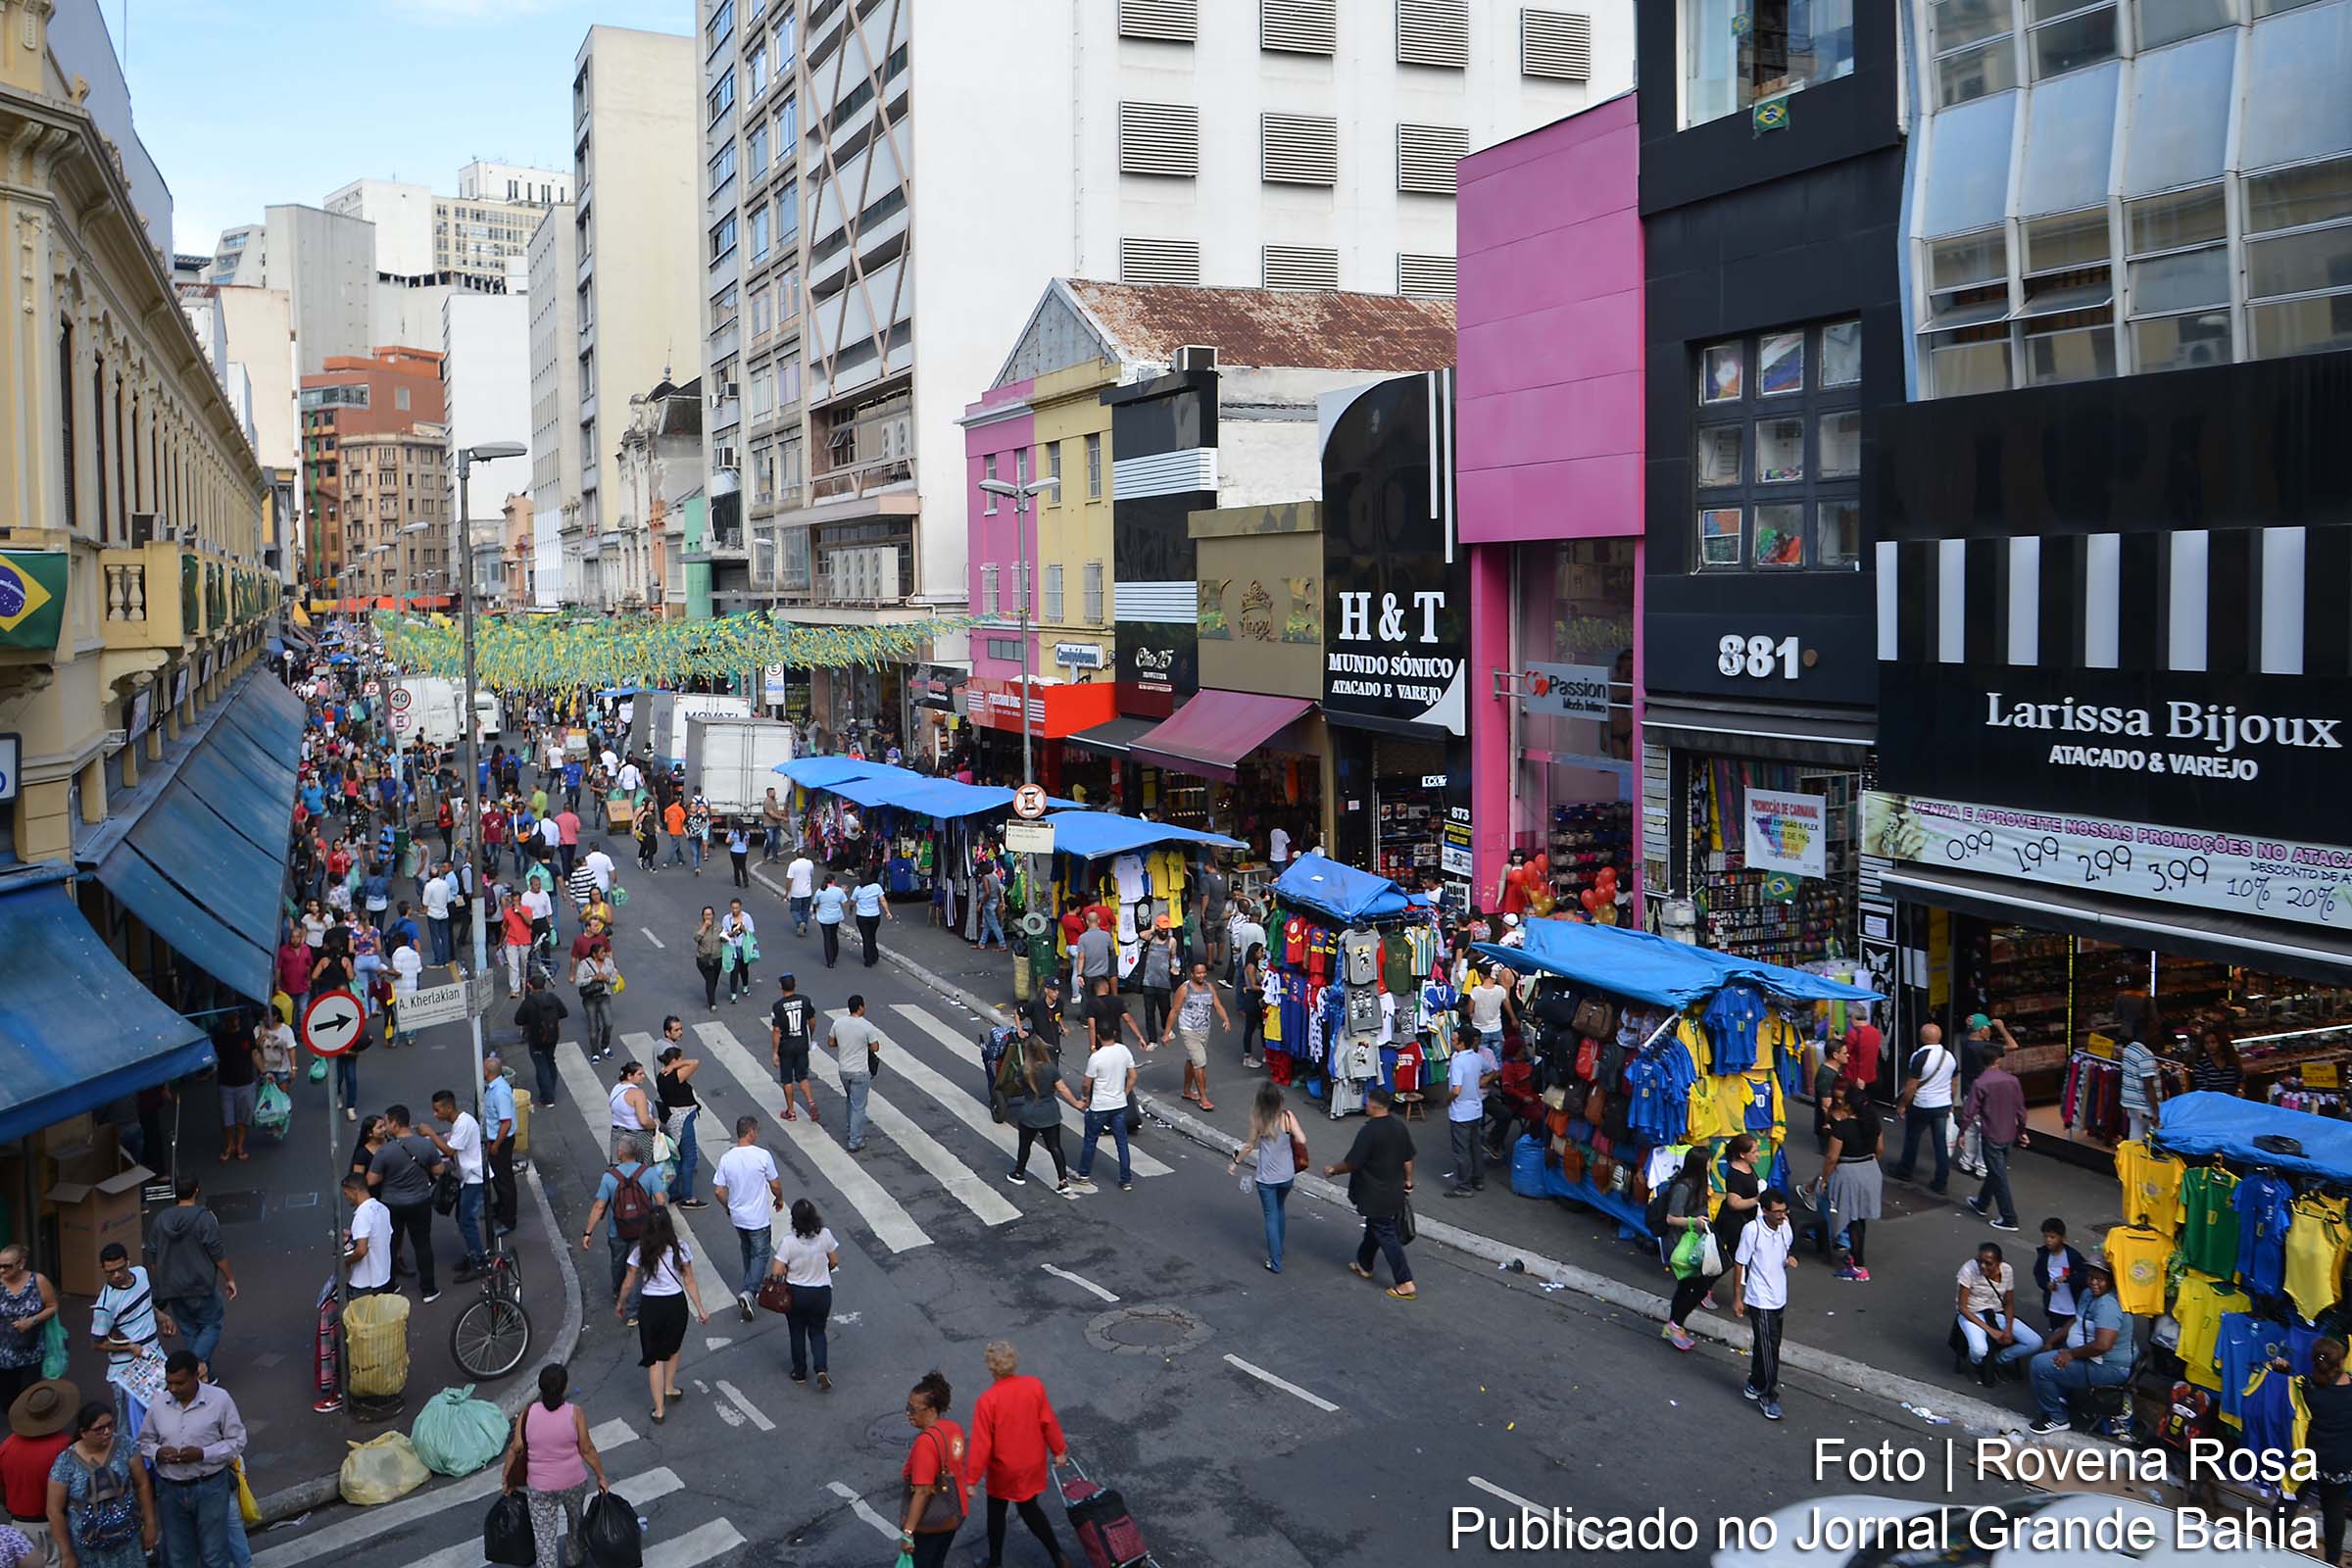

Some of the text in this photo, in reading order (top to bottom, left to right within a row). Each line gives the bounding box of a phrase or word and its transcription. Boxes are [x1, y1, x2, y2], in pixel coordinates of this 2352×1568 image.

[1339, 591, 1446, 643] H & T
[1328, 651, 1454, 678] MUNDO SÔNICO
[1718, 634, 1799, 680] 881
[392, 694, 408, 703] 40
[1331, 679, 1443, 707] ATACADO E VAREJO
[1549, 675, 1606, 699] Passion
[1984, 692, 2343, 753] Larissa Bijoux
[2048, 745, 2258, 781] ATACADO & VAREJO
[1911, 800, 1960, 820] VENHA
[1962, 807, 1974, 822] E
[1975, 808, 2062, 832] APROVEITE
[2065, 818, 2133, 842] NOSSAS
[2136, 827, 2253, 858] PROMOÇÕES
[2257, 841, 2287, 861] NO
[1946, 829, 1993, 861] 0.99
[2077, 844, 2132, 882] 2.99
[2147, 855, 2210, 893] 3.99
[2226, 875, 2272, 911] 10%
[2285, 886, 2336, 922] 20%
[2249, 860, 2319, 880] DESCONTO
[2320, 870, 2339, 883] DE
[398, 988, 461, 1011] A. Kherlakian
[786, 1008, 803, 1032] 10
